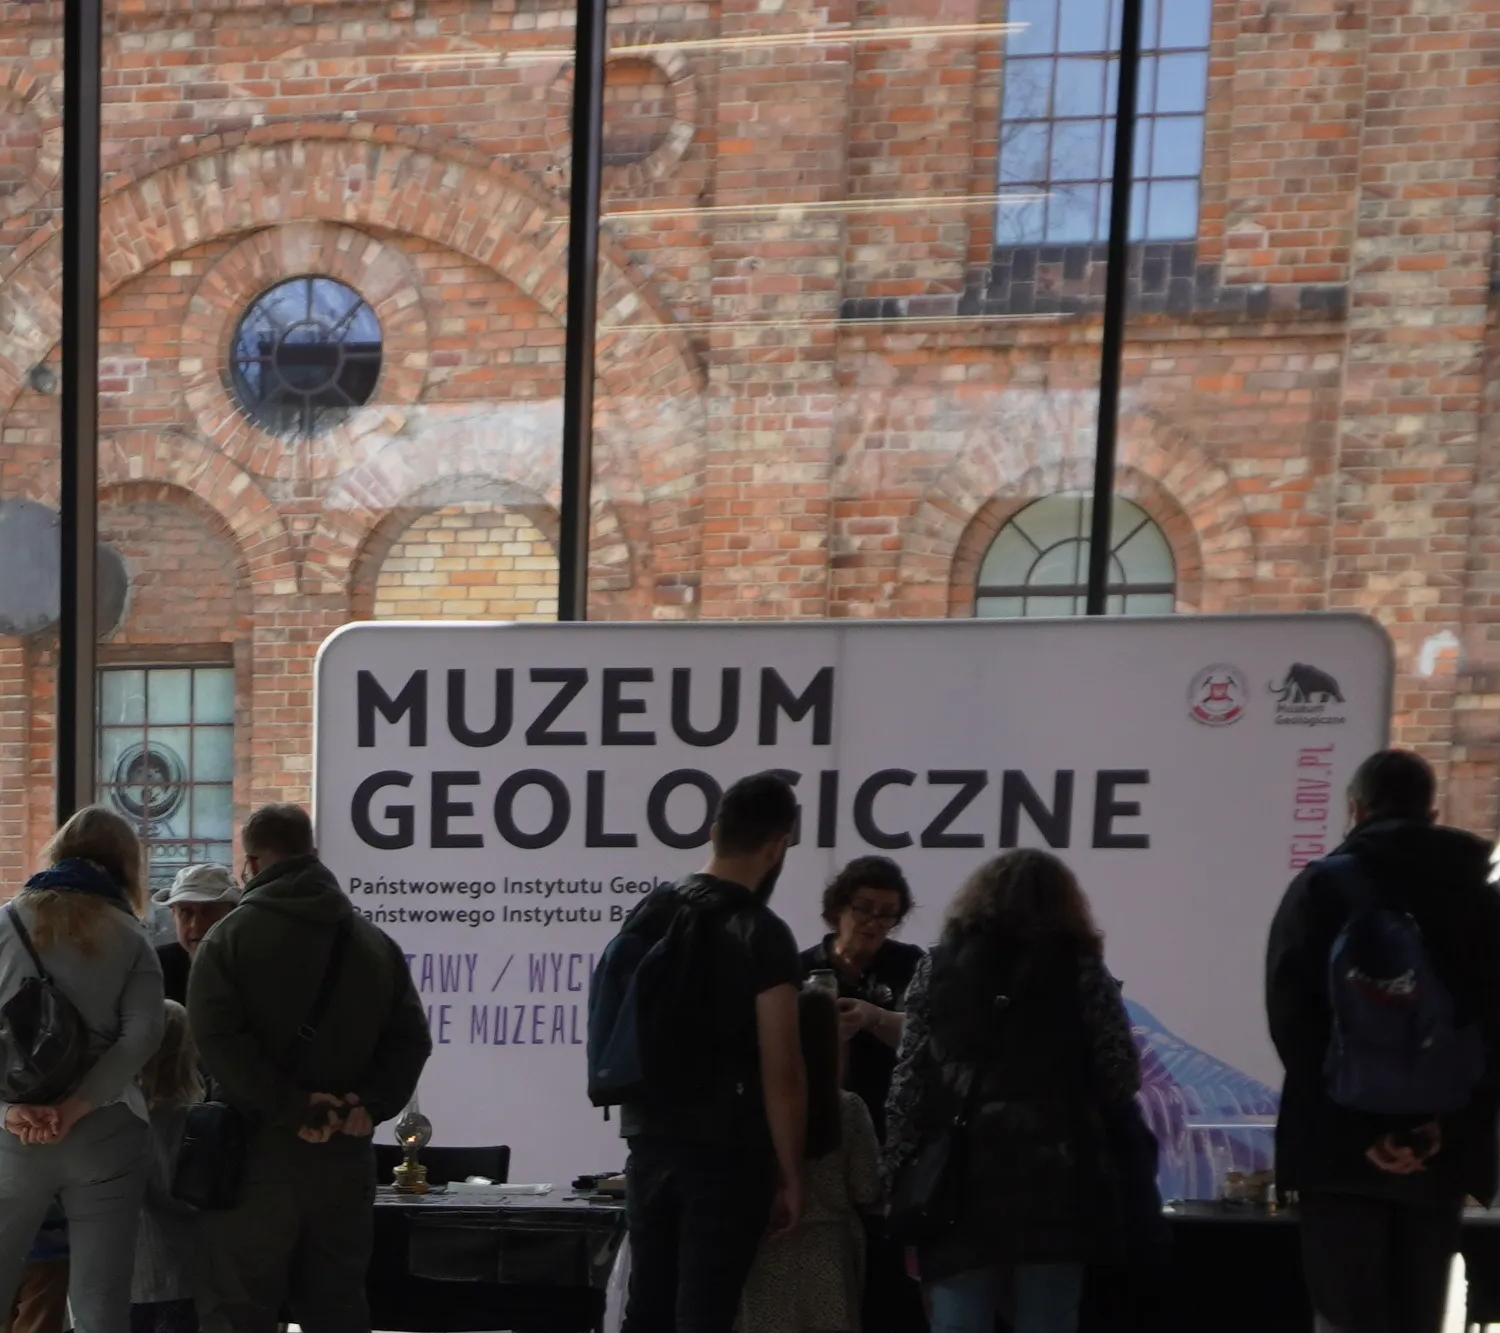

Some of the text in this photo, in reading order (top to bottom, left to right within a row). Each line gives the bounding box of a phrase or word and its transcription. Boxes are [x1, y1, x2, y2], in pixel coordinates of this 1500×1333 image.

[355, 665, 837, 749] MUZEUM
[349, 876, 496, 898] Państwowego
[503, 877, 603, 898] Instytutu
[503, 905, 602, 926] Instytutu
